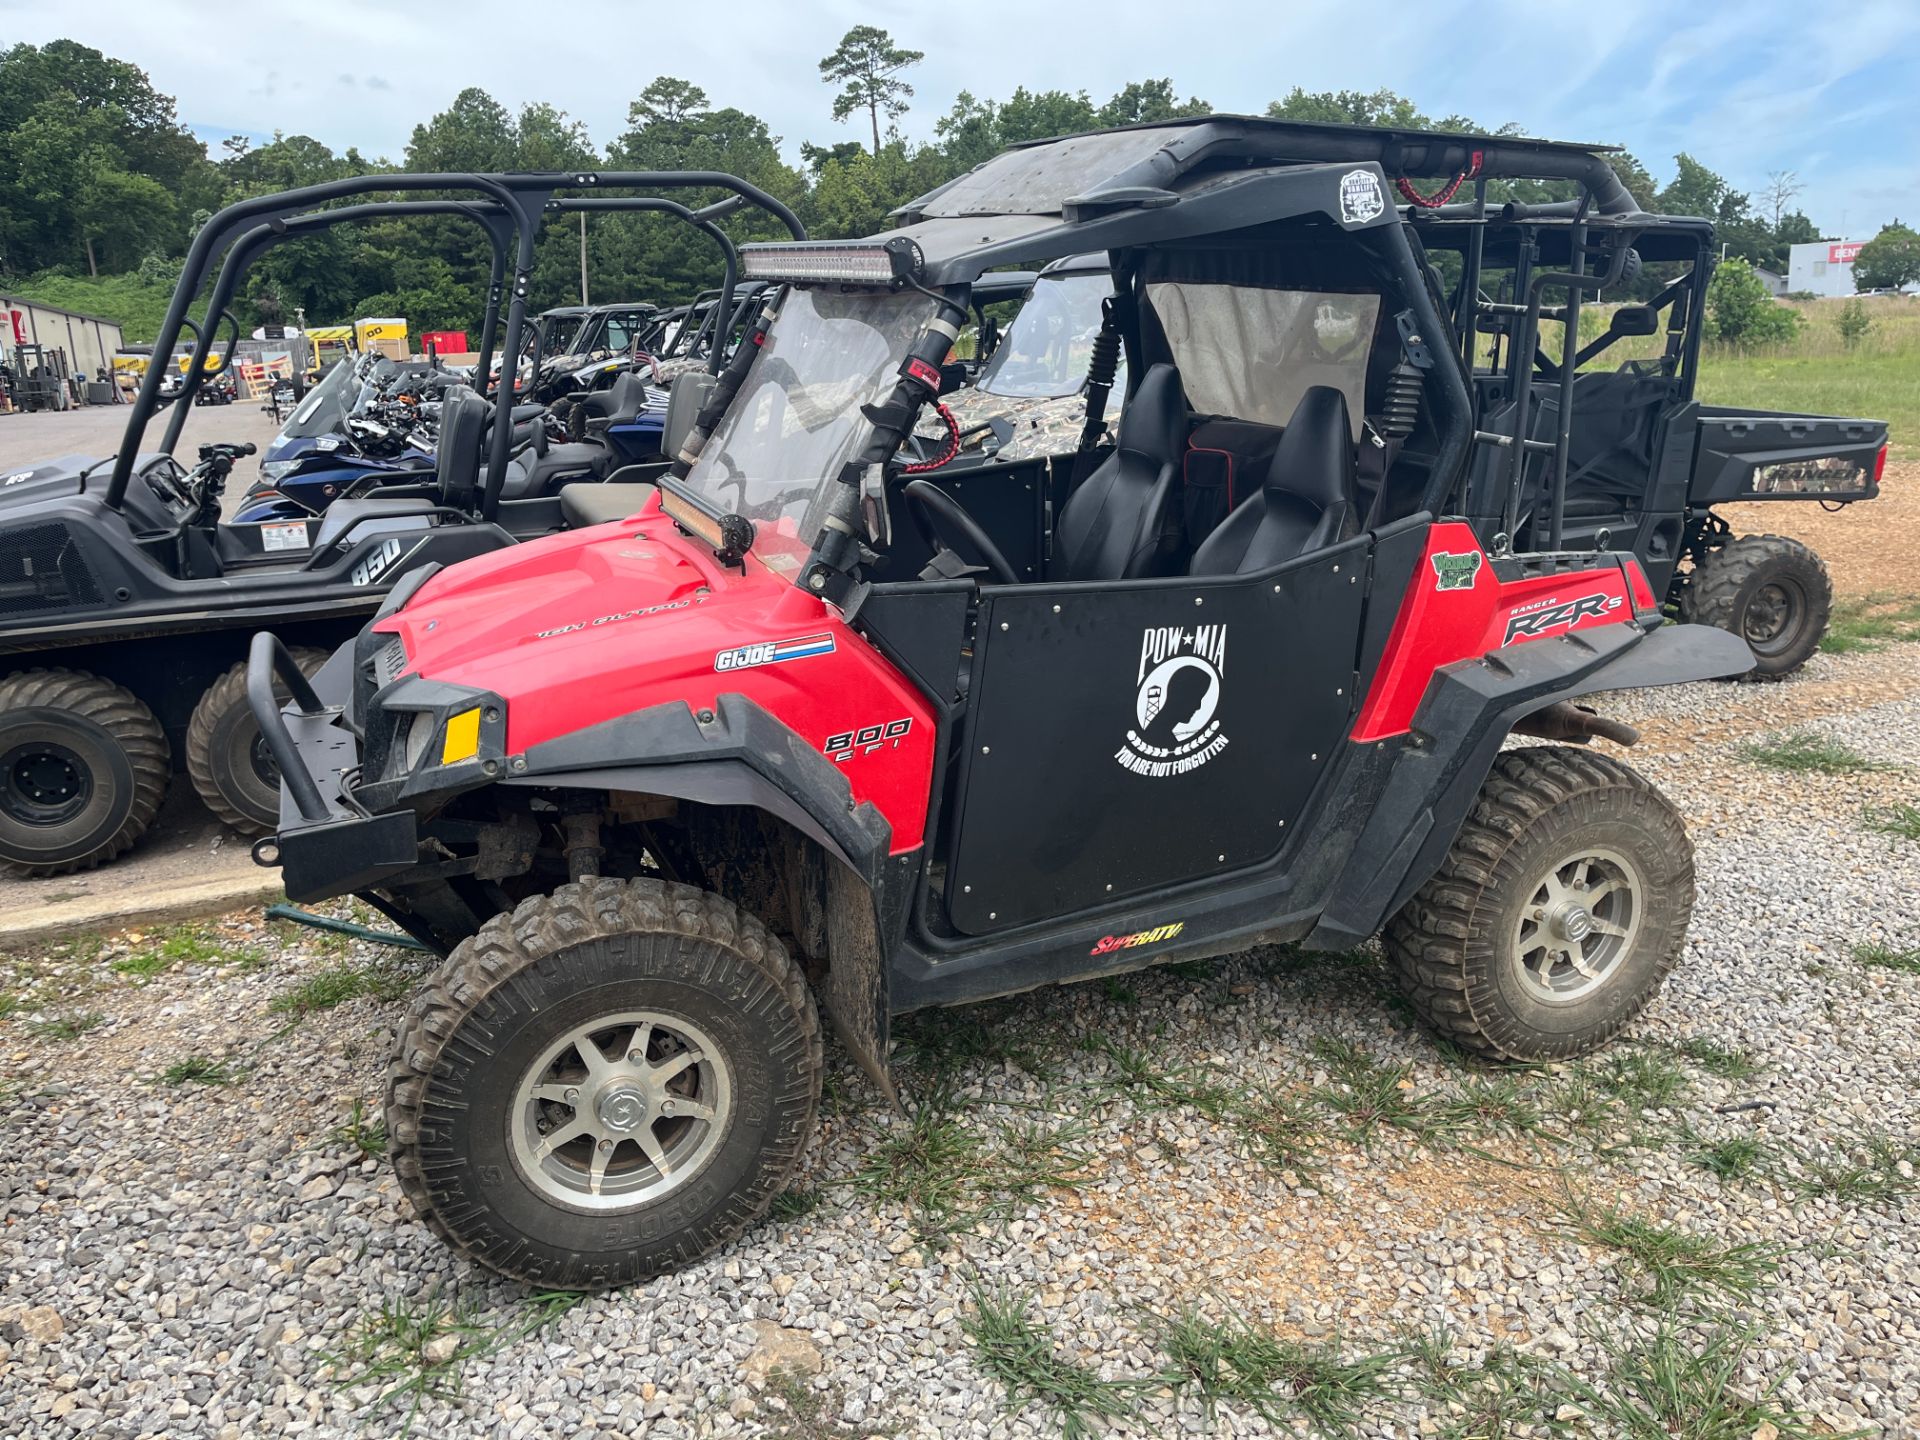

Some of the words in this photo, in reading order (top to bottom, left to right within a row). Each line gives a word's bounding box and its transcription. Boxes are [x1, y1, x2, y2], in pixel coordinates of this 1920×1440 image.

[351, 538, 401, 586] 850
[1501, 593, 1609, 648] RZR
[1510, 598, 1557, 615] RANGER
[1136, 626, 1184, 687] POW
[1193, 624, 1227, 679] MIA
[823, 717, 913, 754] 800
[834, 738, 900, 762] EFI
[1114, 745, 1132, 768] YOU
[1130, 757, 1151, 777] ARE
[1149, 761, 1173, 777] NOT
[1172, 734, 1229, 775] FORGOTTEN
